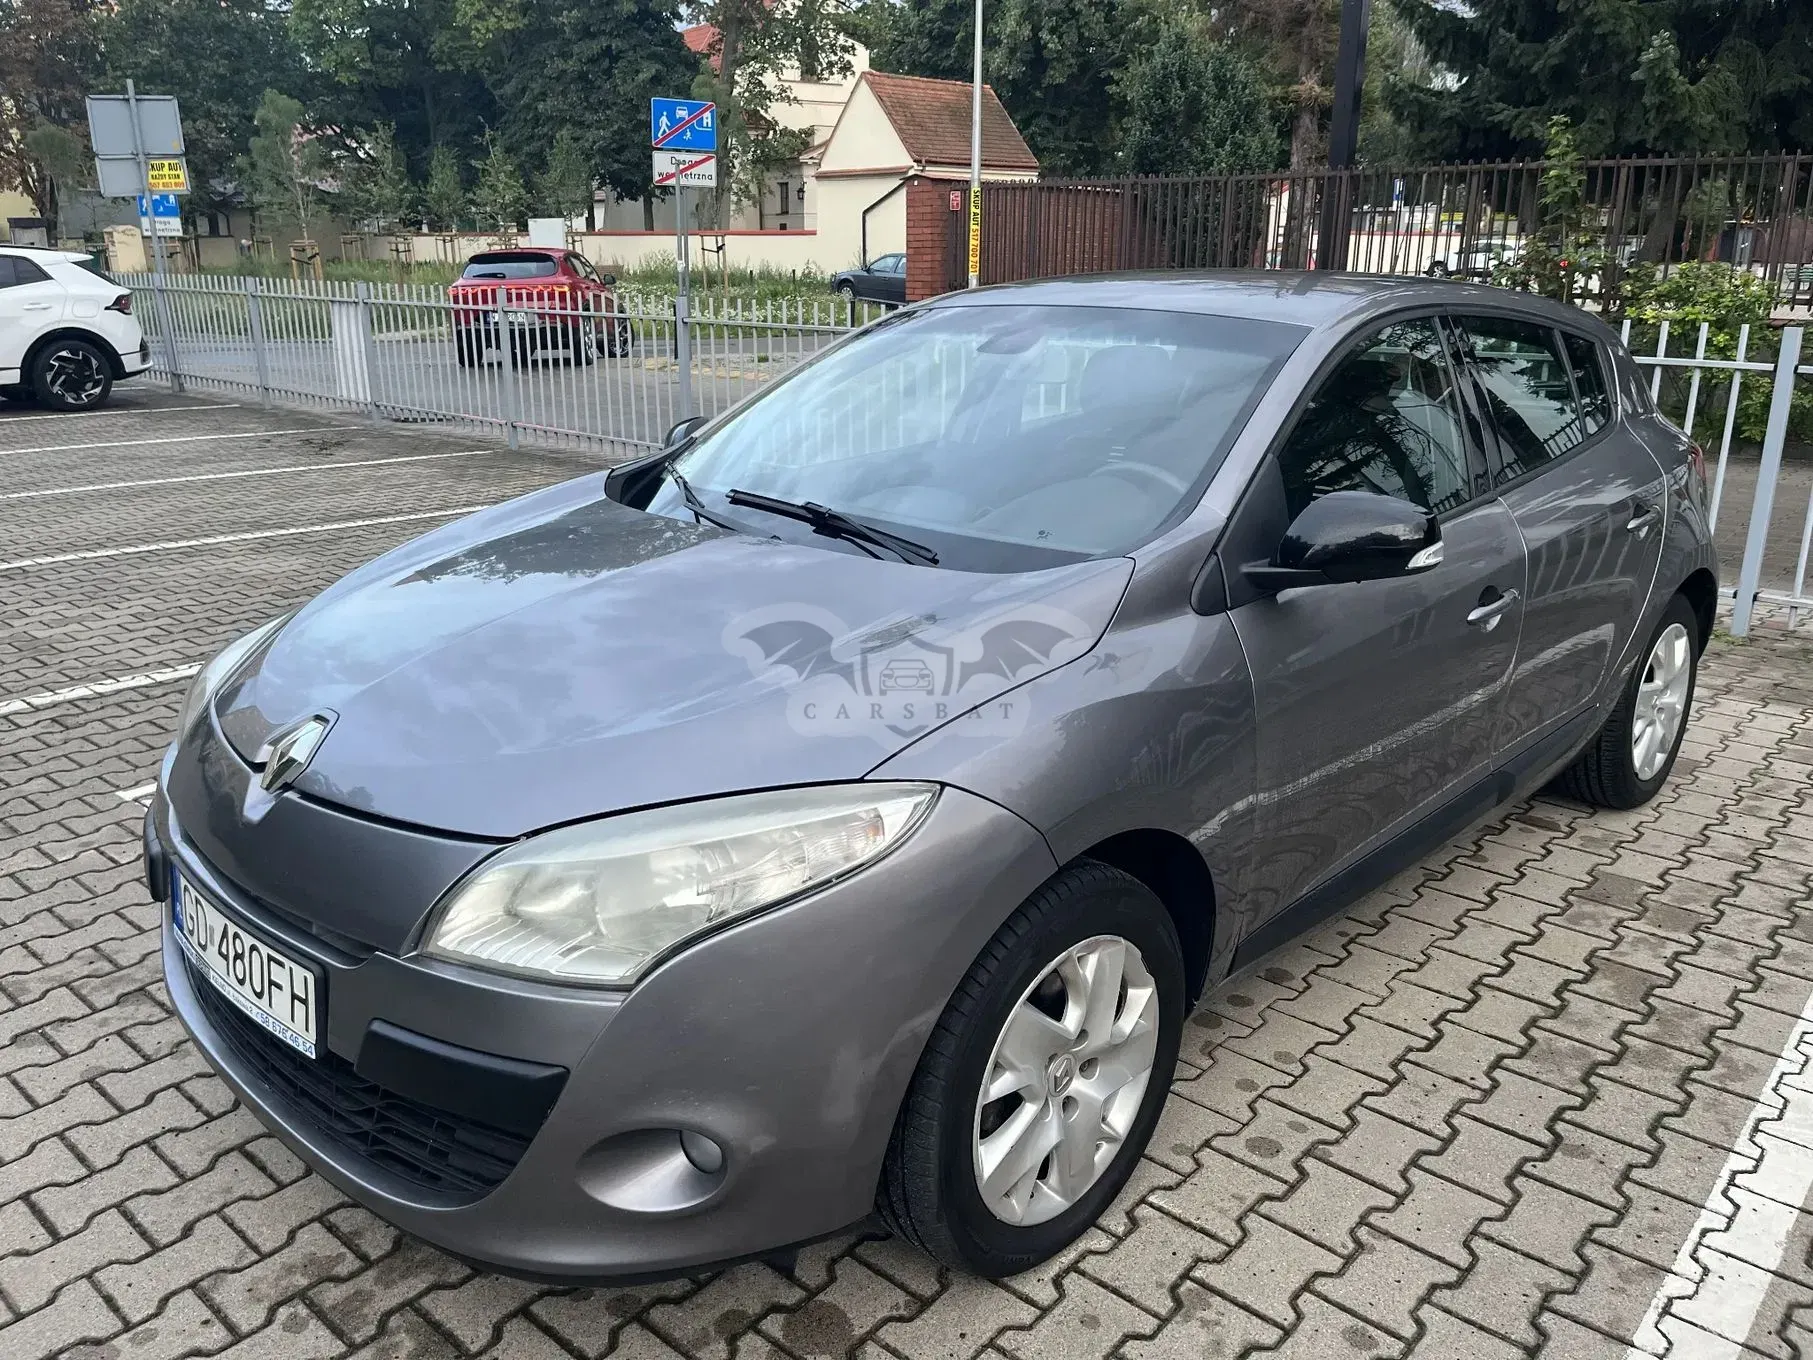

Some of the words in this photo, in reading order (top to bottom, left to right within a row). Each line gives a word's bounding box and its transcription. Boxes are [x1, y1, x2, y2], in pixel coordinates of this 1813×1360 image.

[149, 162, 165, 171] KUP
[972, 189, 980, 210] SKUP
[972, 211, 980, 226] AUT
[971, 229, 979, 241] 517
[971, 243, 979, 258] 700
[970, 260, 978, 273] 701
[184, 884, 207, 952] GD
[218, 922, 310, 1034] 480FH
[302, 1041, 313, 1056] 54
